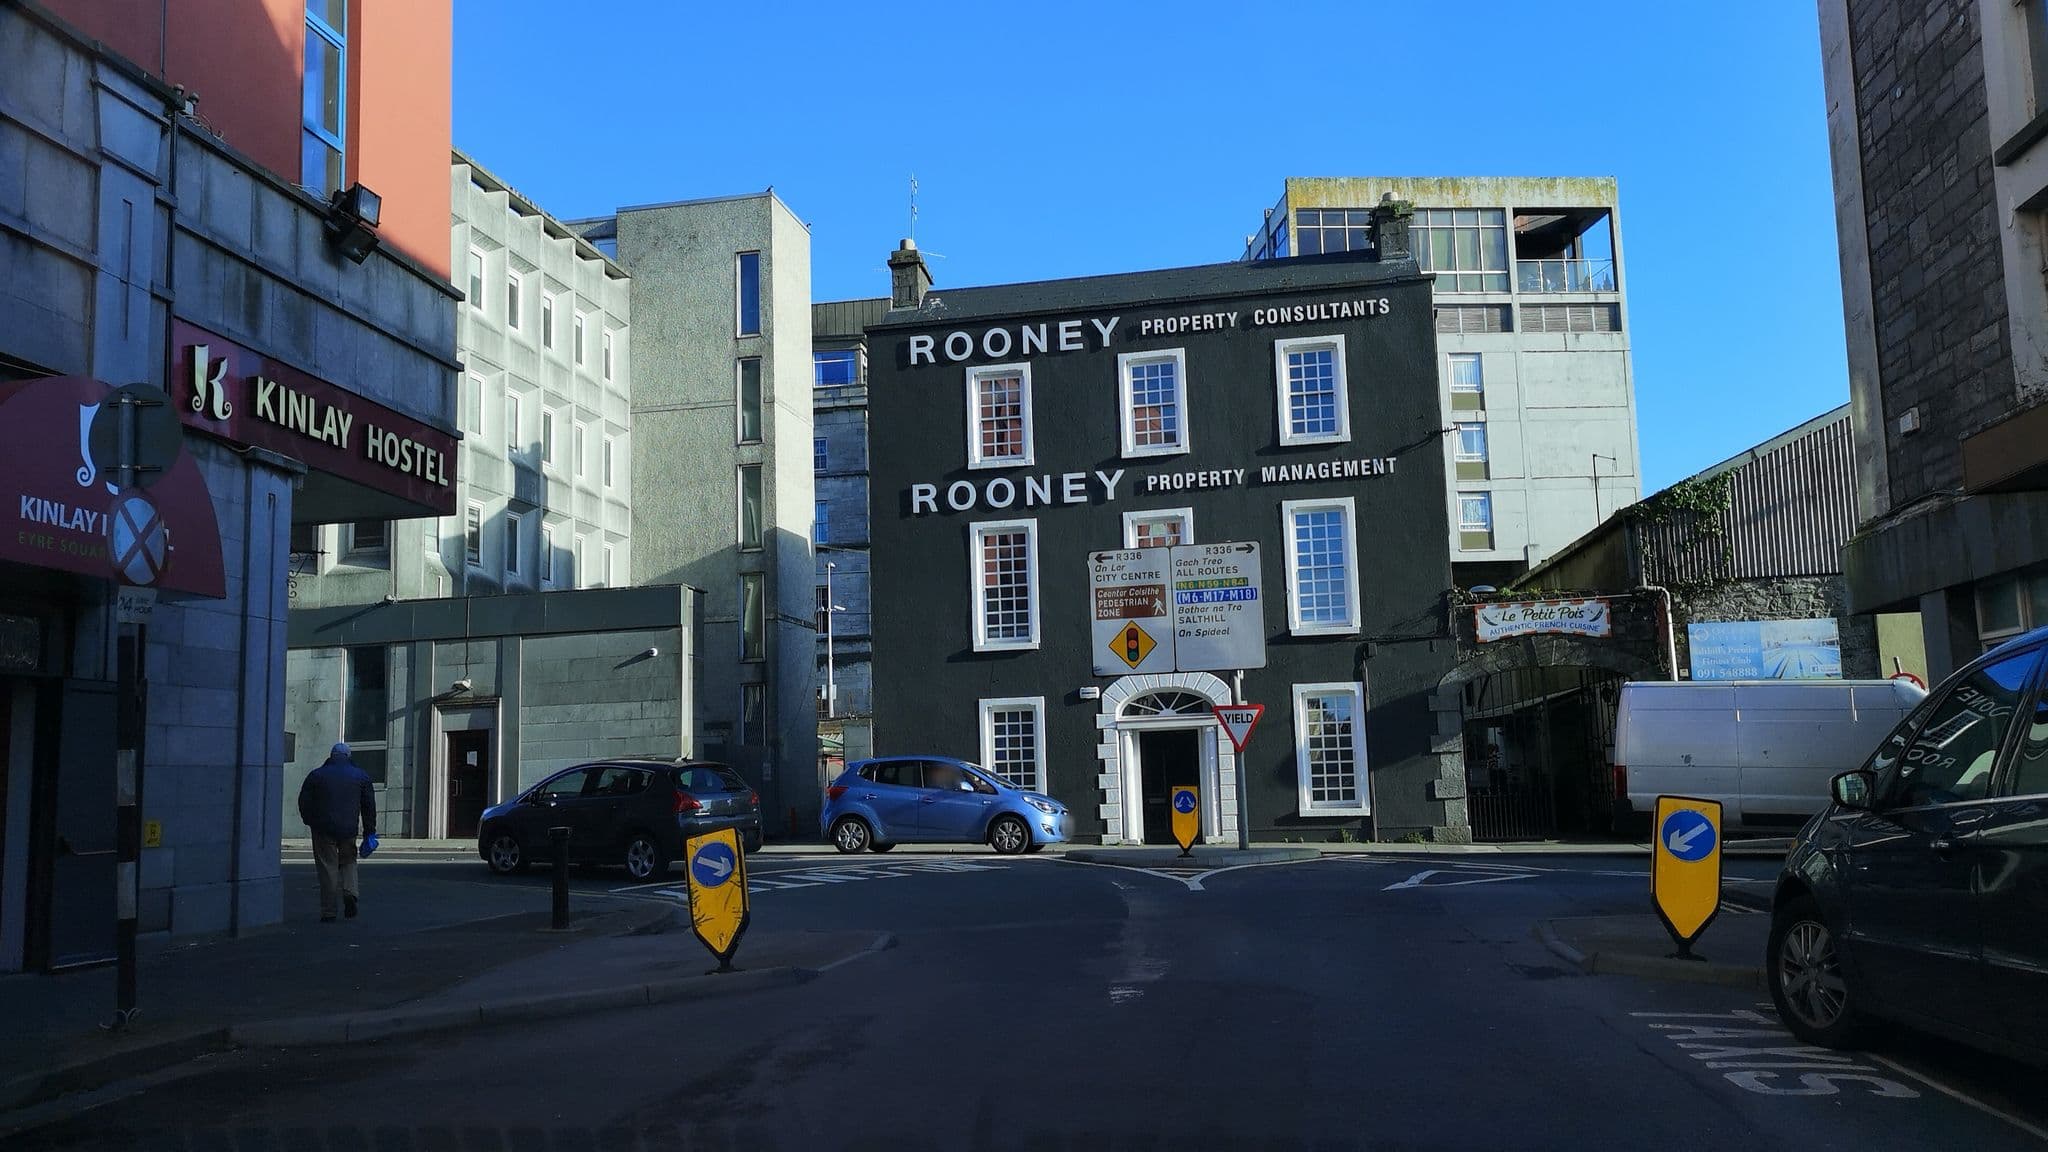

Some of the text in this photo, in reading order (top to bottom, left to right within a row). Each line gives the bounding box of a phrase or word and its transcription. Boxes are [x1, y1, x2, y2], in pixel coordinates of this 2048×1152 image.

[909, 297, 1391, 366] ROONEY PROPERTY CONSULTANTS
[256, 376, 449, 488] KINLAY HOSTEL
[911, 456, 1398, 515] ROONEY PROPERTY MANAGEMENT
[20, 494, 99, 534] KINLAY
[18, 531, 51, 550] EYRE
[1095, 570, 1161, 583] CITY CENTRE
[1176, 565, 1239, 577] ALL ROUTES
[1098, 597, 1149, 608] PEDESTRIAN
[1213, 605, 1224, 613] na
[1098, 608, 1121, 618] ZONE
[1178, 614, 1226, 625] SALTHILL
[1502, 605, 1585, 622] Le Petit Pois
[1489, 620, 1601, 636] AUTHENTIC FRENCH CUISINE
[1697, 667, 1759, 678] 091 548888
[1225, 713, 1253, 724] YIELD
